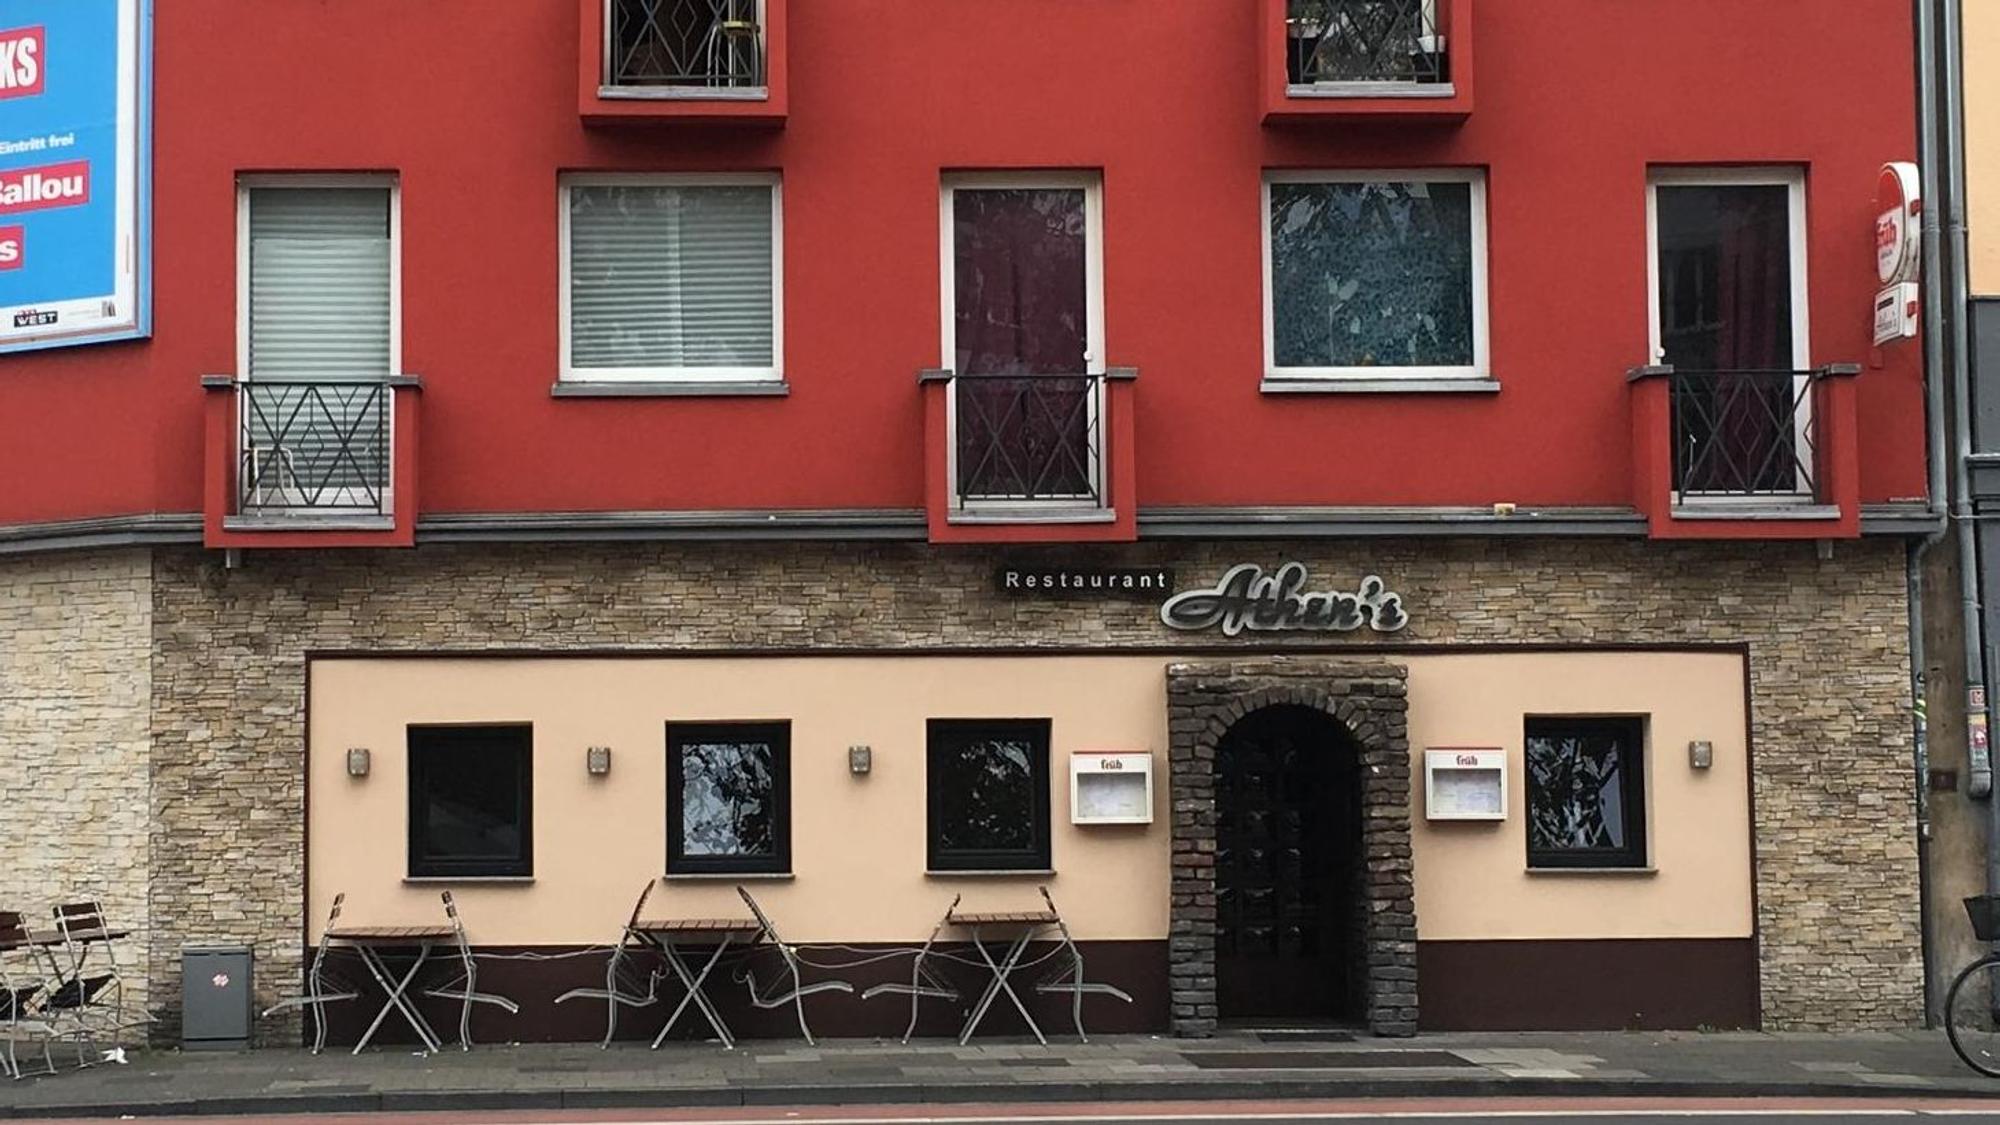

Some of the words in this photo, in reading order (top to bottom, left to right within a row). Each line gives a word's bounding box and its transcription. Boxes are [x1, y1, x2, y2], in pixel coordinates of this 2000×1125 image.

[49, 132, 75, 148] frei
[0, 173, 84, 206] allou
[1005, 571, 1166, 588] Restaurant
